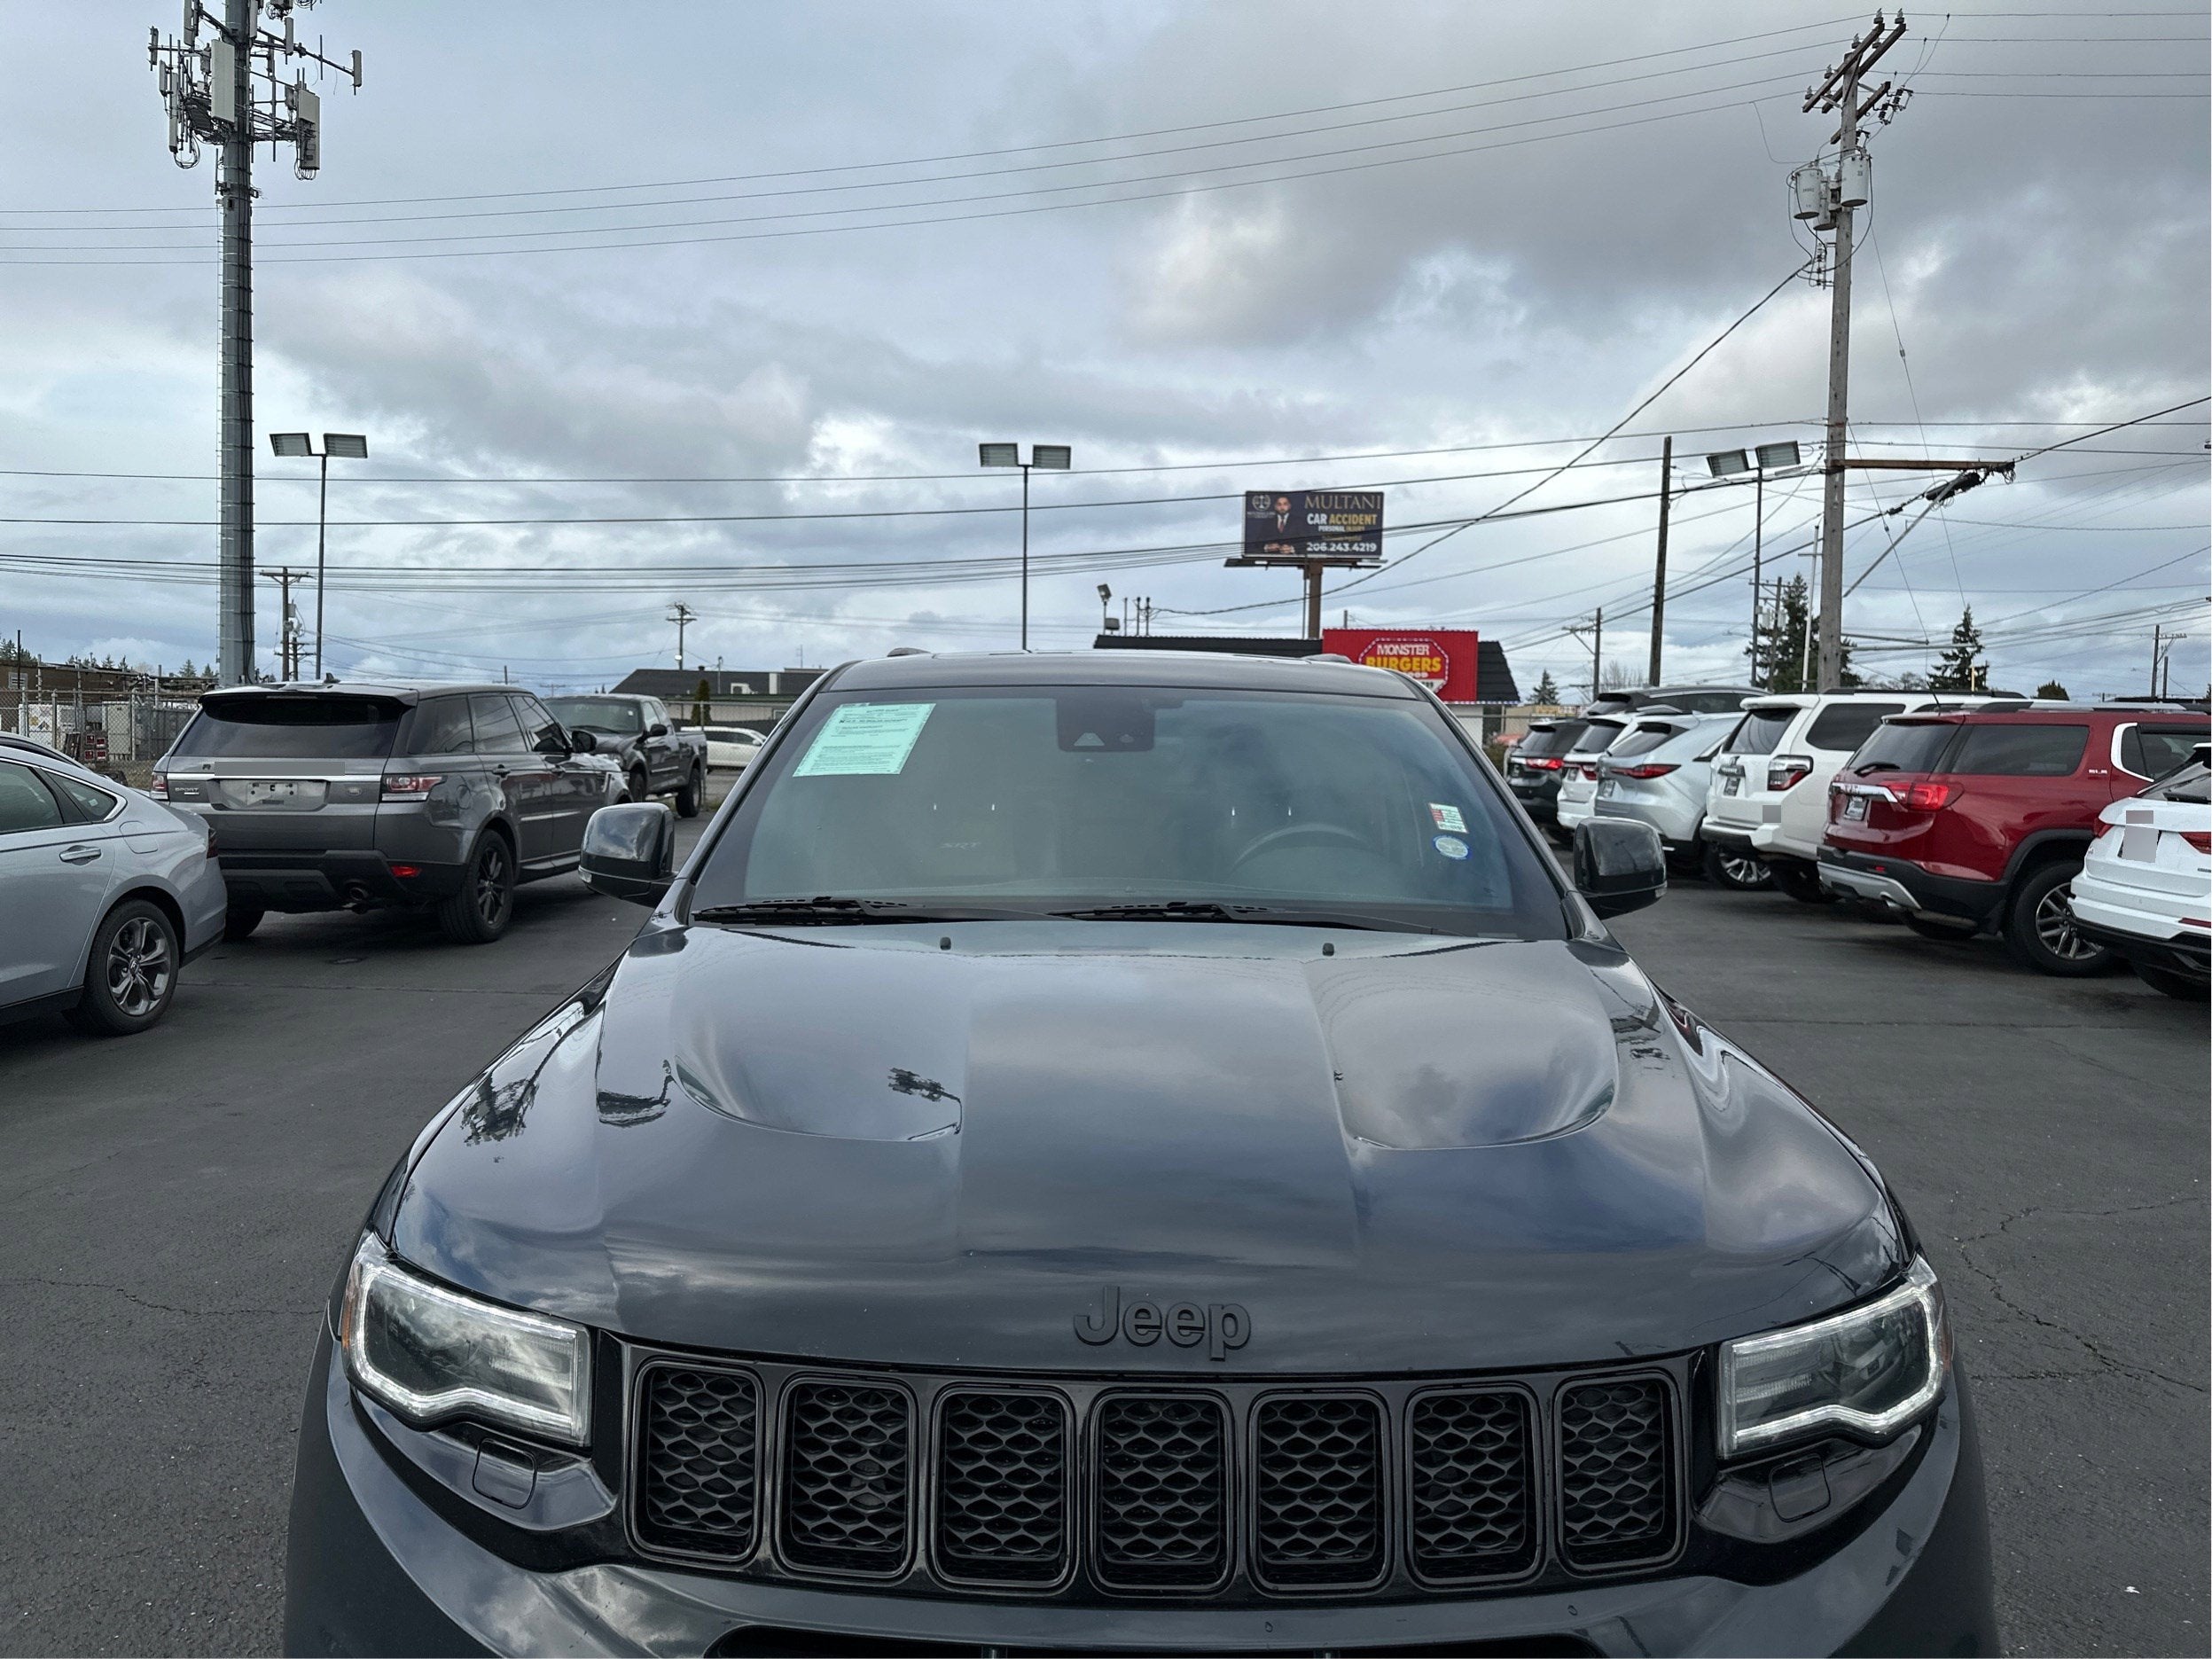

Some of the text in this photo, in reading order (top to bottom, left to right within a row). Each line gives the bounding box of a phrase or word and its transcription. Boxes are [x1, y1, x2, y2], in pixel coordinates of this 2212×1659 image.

[1304, 495, 1381, 510] MULTANI
[1307, 513, 1377, 525] CAR ACCIDENT
[1306, 542, 1378, 552] 206.243.4219
[1377, 644, 1430, 655] MONSTER
[1366, 657, 1442, 672] BURGERS
[1074, 1286, 1252, 1361] Jeep
